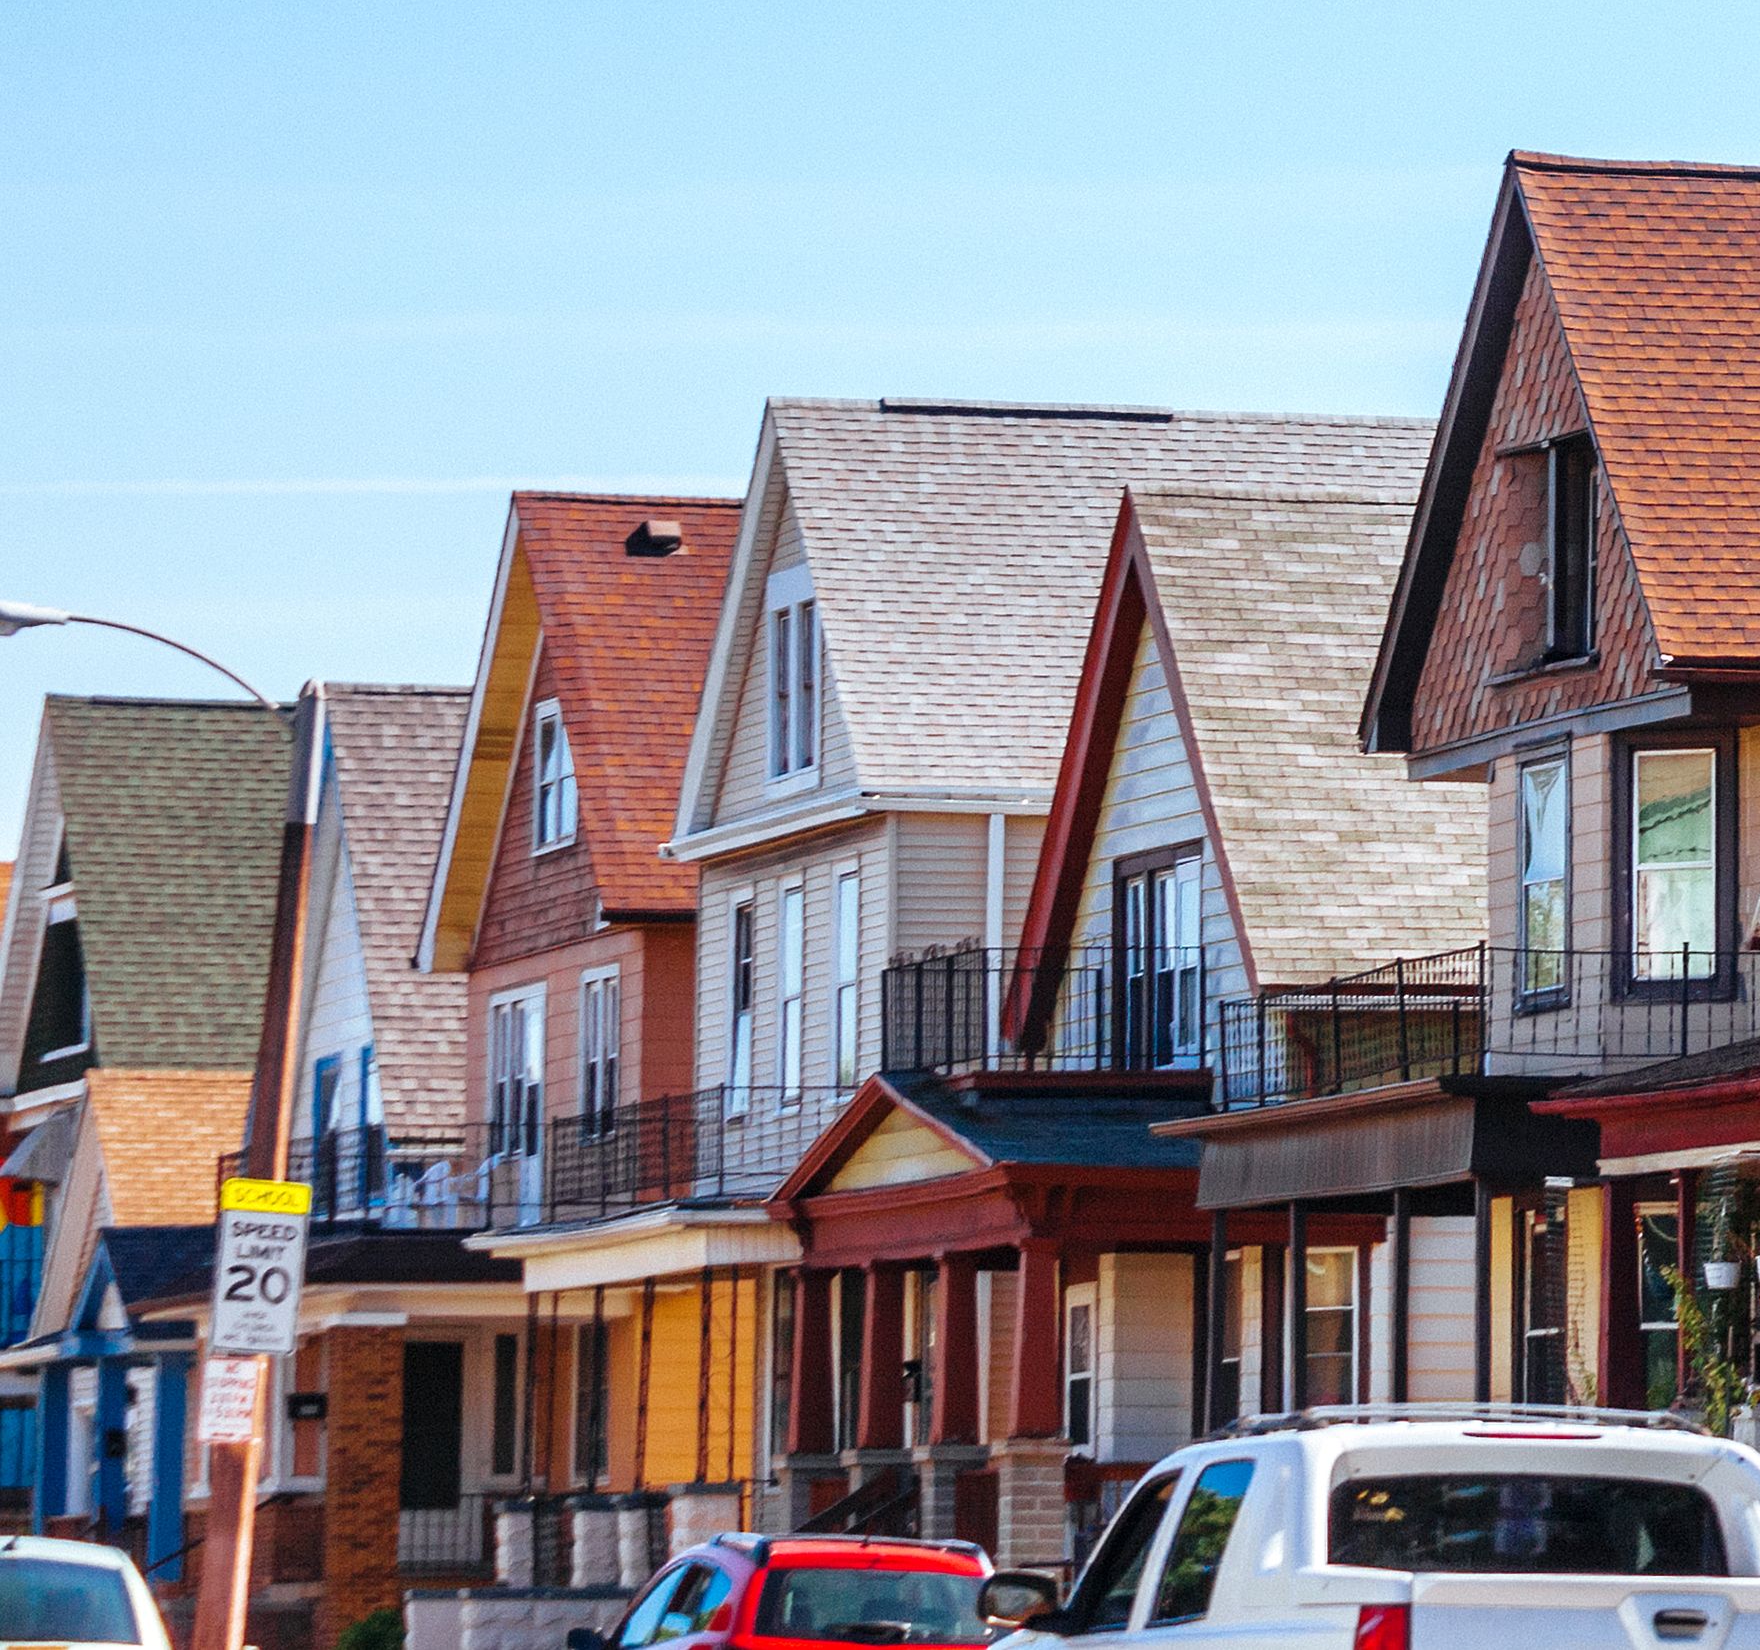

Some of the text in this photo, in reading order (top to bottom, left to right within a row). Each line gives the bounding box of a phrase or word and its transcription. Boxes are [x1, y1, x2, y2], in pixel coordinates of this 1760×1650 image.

[233, 1188, 300, 1207] SCHOOL
[232, 1220, 298, 1242] SPEED
[236, 1243, 287, 1261] LIMIT
[223, 1264, 290, 1305] 20
